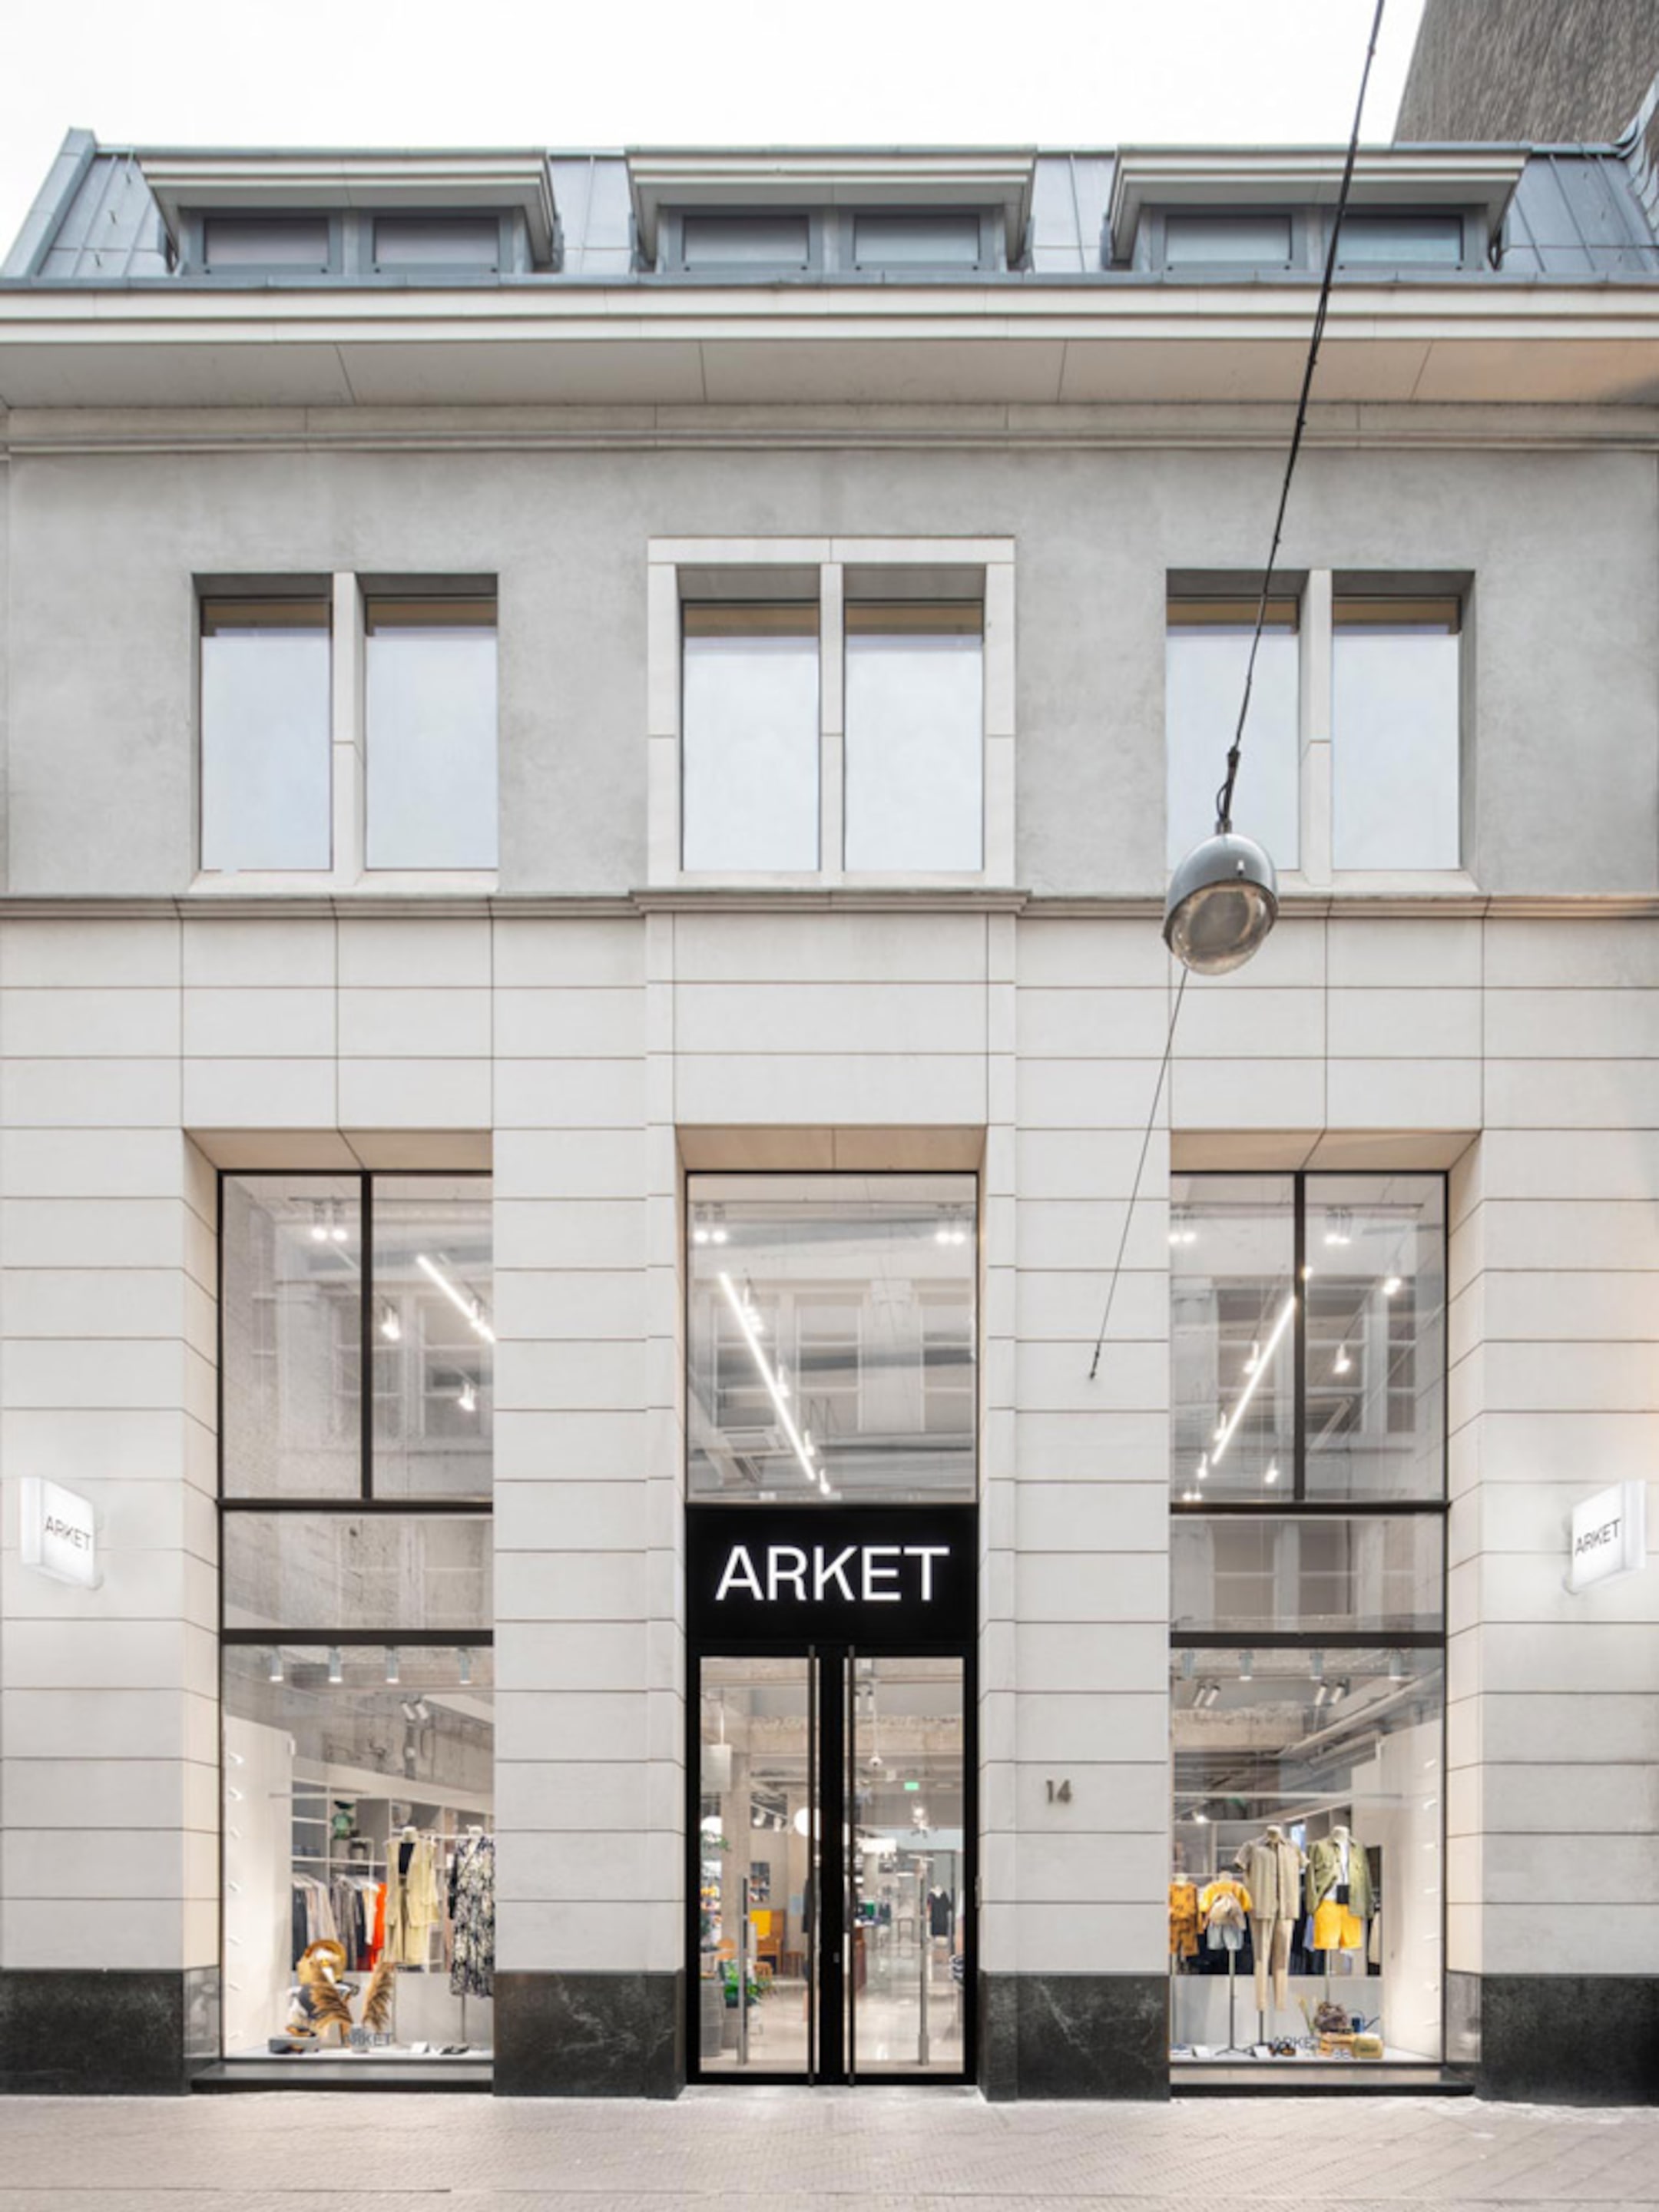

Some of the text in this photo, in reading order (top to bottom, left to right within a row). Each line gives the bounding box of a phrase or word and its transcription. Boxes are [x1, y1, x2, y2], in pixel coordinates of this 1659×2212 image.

[45, 1515, 91, 1550] ARKET
[1575, 1518, 1621, 1556] ARKET
[715, 1545, 950, 1601] ARKET
[1045, 1779, 1073, 1804] 14
